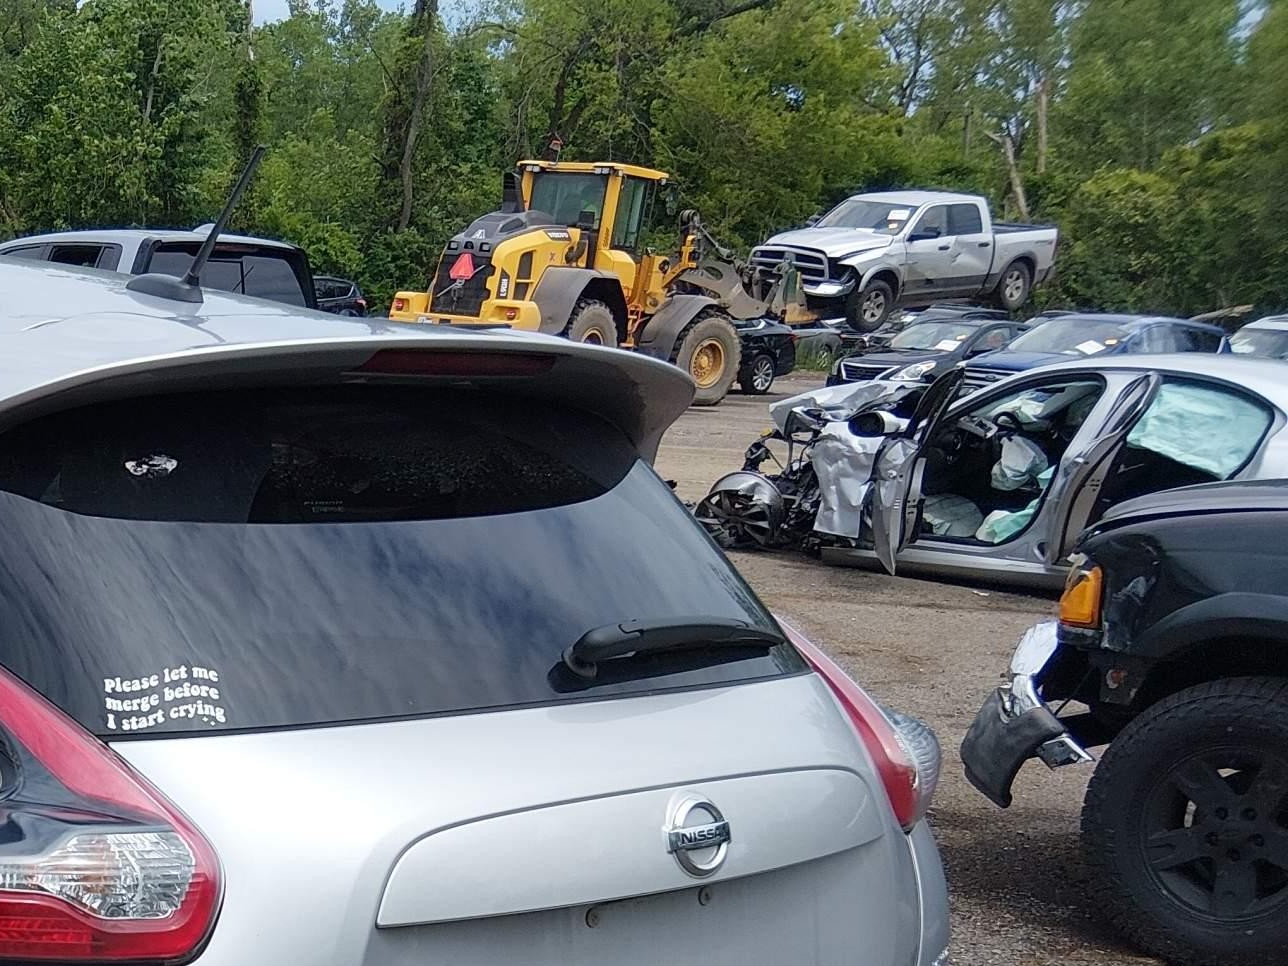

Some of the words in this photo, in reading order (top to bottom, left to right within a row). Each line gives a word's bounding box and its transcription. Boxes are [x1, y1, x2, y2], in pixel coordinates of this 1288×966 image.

[104, 673, 159, 693] Please
[163, 665, 188, 683] let
[192, 666, 219, 682] me
[105, 693, 160, 712] merge
[163, 682, 220, 701] before
[106, 713, 117, 730] I
[121, 709, 166, 731] start
[169, 700, 227, 723] crying
